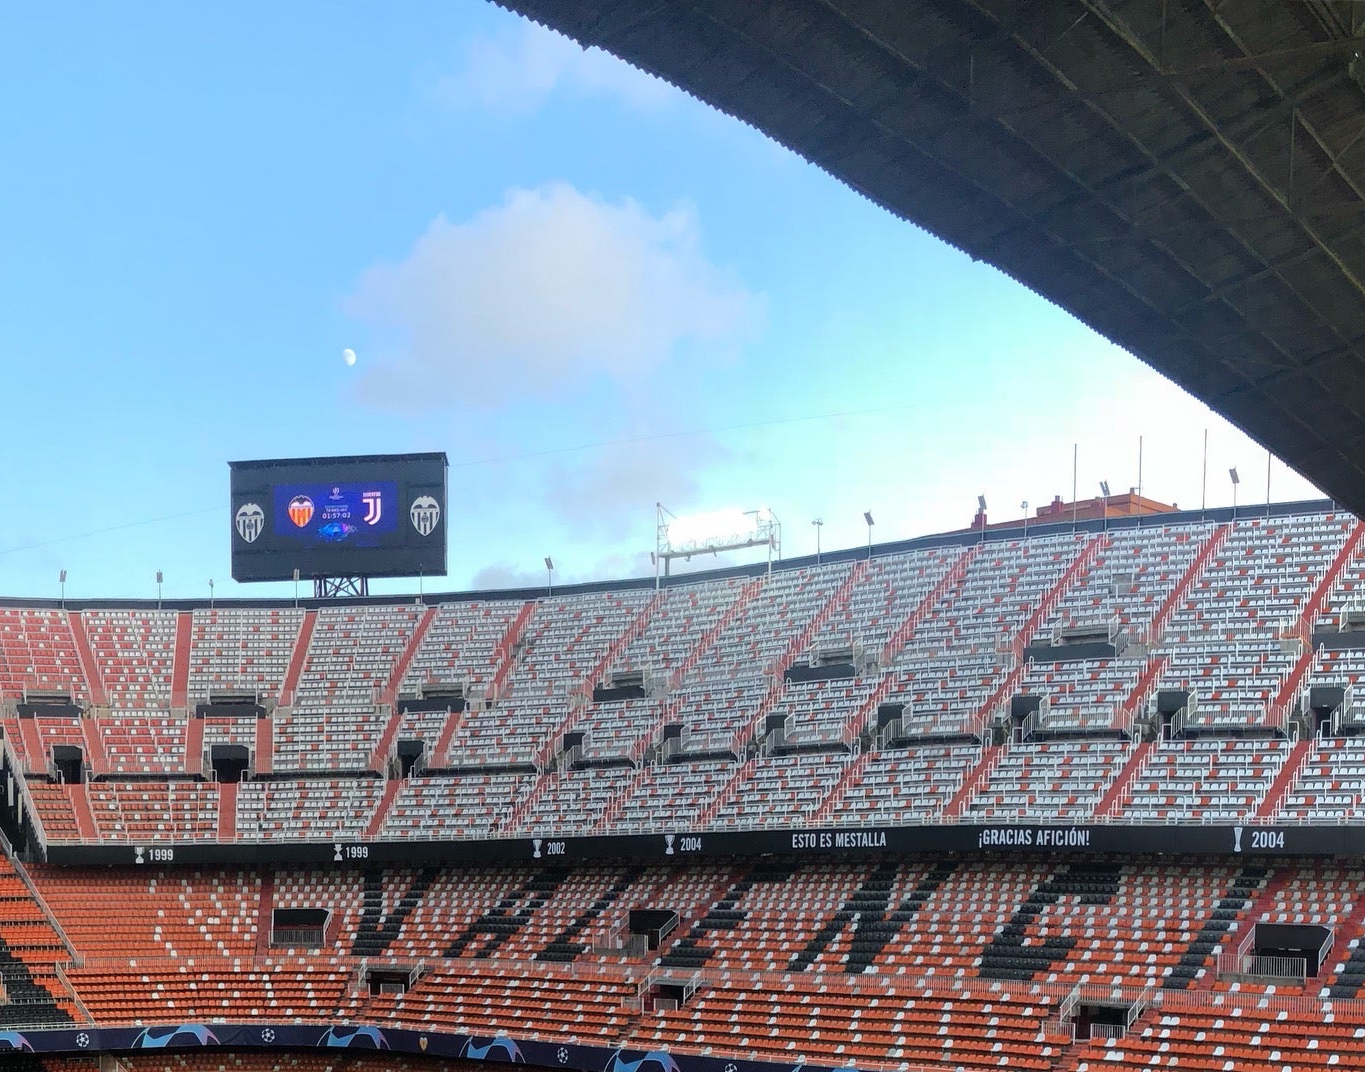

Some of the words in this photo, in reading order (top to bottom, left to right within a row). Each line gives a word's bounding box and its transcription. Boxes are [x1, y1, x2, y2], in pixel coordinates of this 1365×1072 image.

[792, 833, 817, 849] ESTO
[819, 833, 833, 848] ES
[835, 831, 887, 848] MESTALLA
[978, 829, 1033, 849] ¡GRACIAS
[1036, 826, 1091, 847] AFICIÓN!
[1251, 831, 1285, 849] 2004
[547, 842, 566, 855] 2002
[680, 838, 702, 851] 2004
[148, 849, 174, 862] 1999
[345, 846, 369, 859] 1999
